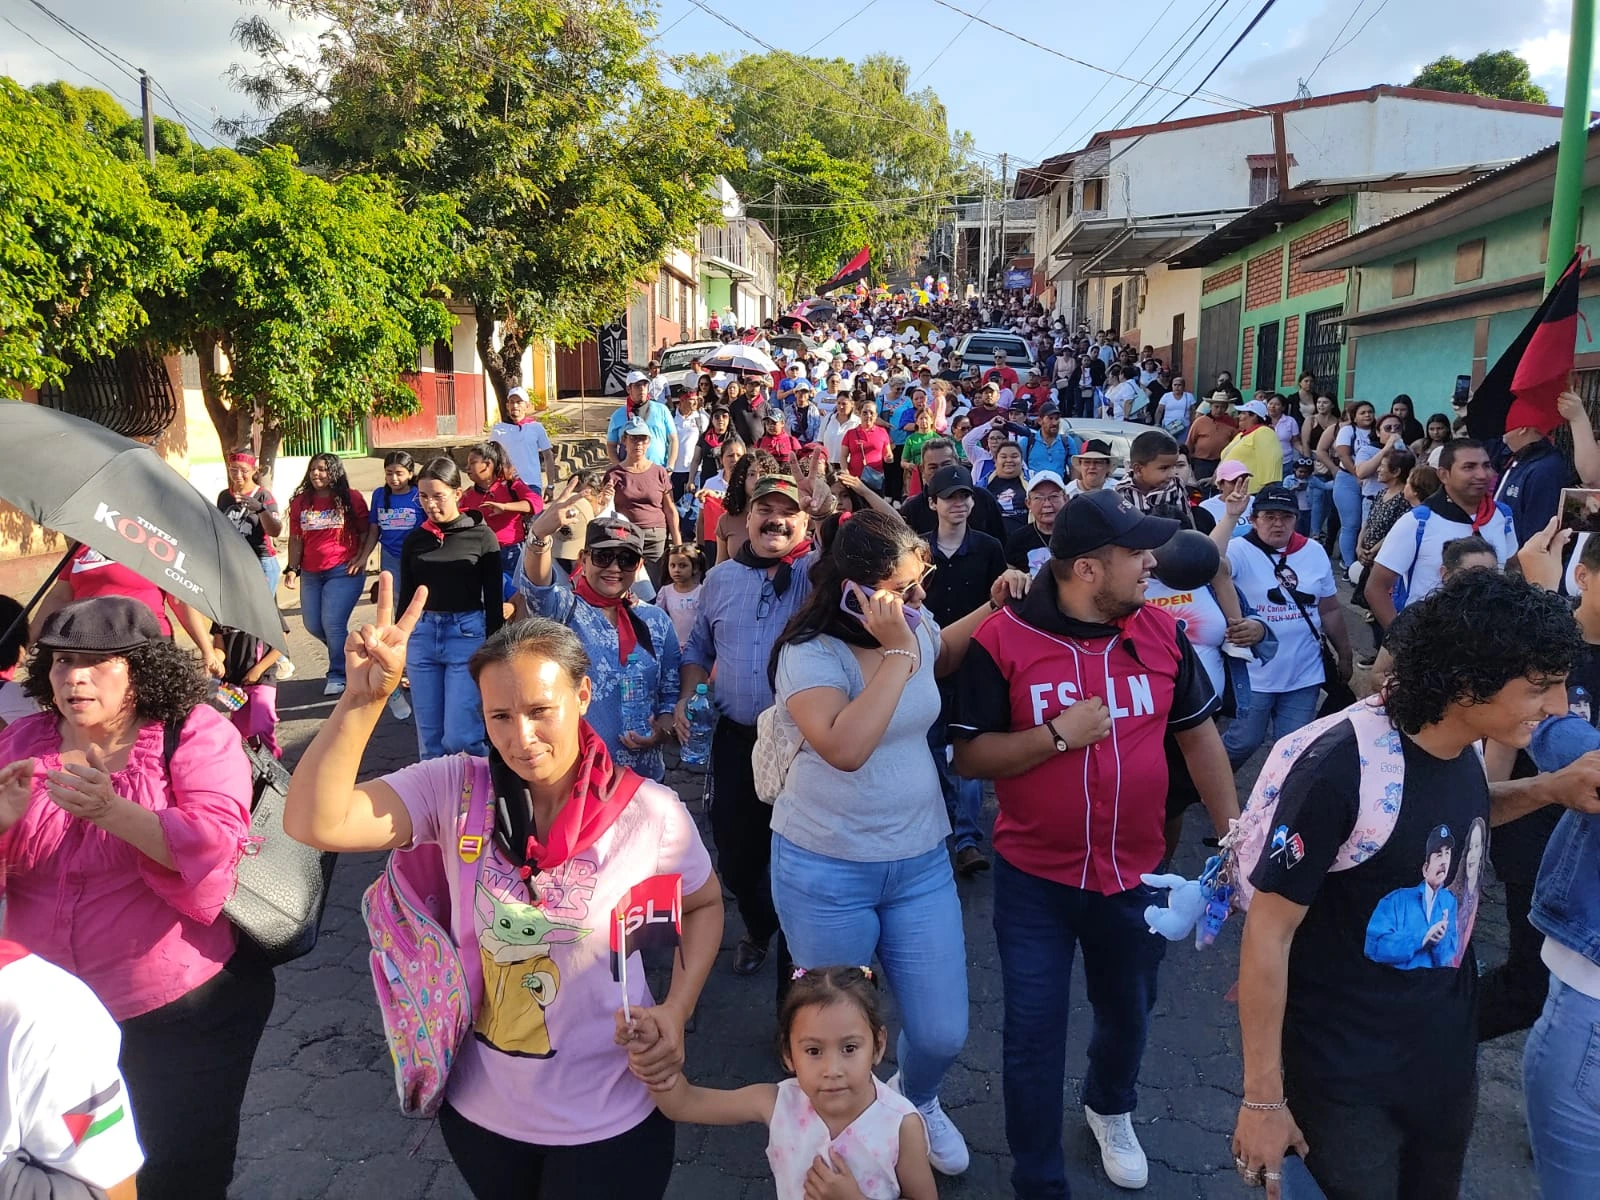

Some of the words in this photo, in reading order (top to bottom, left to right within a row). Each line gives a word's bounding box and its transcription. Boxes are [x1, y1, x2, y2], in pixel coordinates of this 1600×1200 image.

[93, 502, 187, 574] KOOL
[137, 516, 178, 546] TINTES
[165, 568, 201, 594] COLOR
[485, 845, 598, 889] SAR
[625, 899, 682, 936] SL
